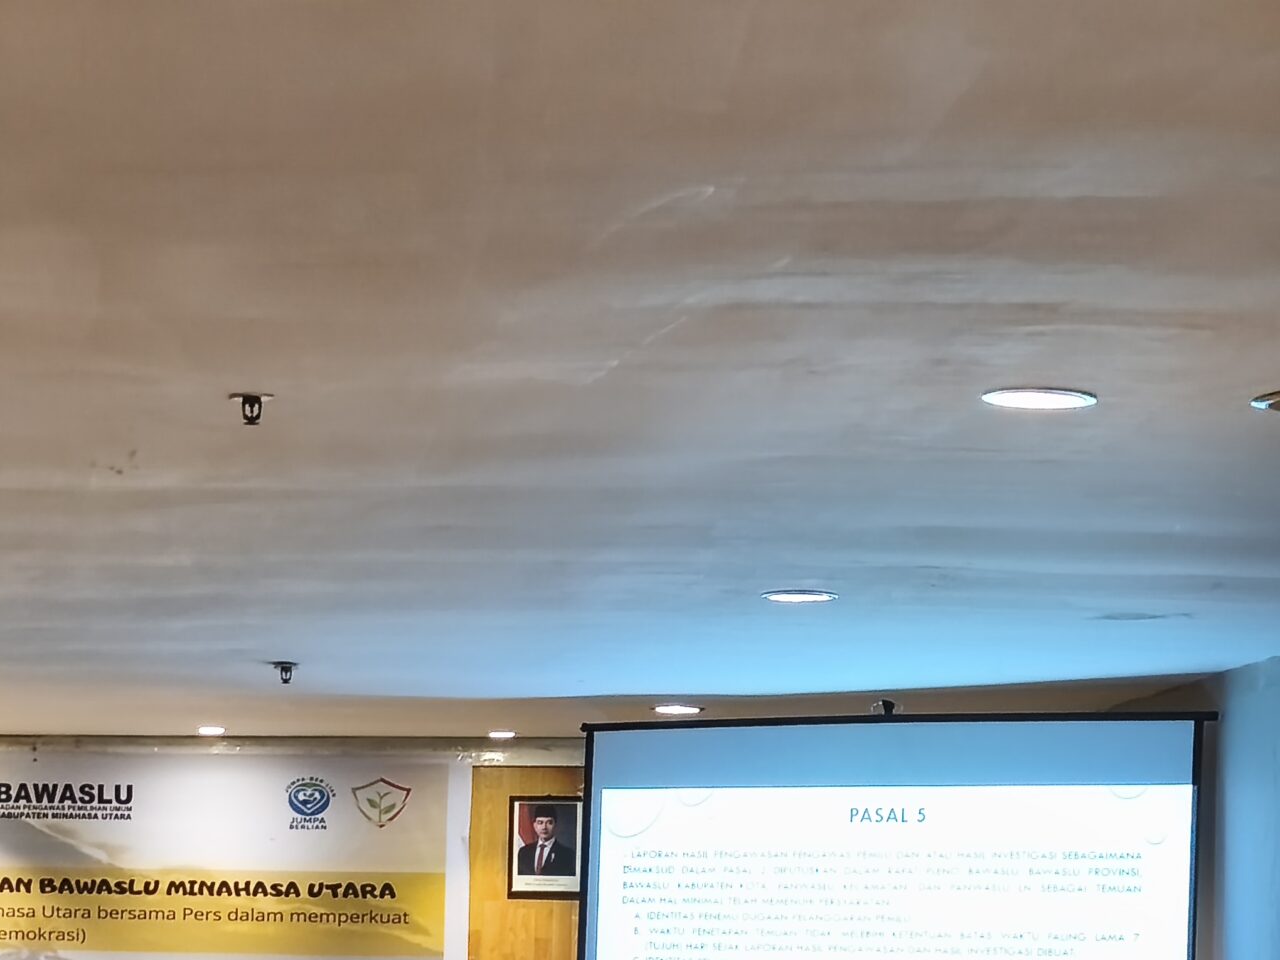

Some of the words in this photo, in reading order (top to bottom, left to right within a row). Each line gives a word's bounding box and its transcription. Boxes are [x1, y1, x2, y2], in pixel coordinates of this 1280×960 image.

[51, 813, 99, 821] MINAHASA
[101, 813, 132, 821] UTARA
[849, 807, 909, 823] PASAL
[917, 807, 927, 823] 5
[290, 817, 326, 825] JUMPA
[631, 850, 678, 859] LAPORAN
[683, 850, 708, 859] HASIL
[1062, 851, 1143, 860] SEBAGAIMANA
[681, 865, 716, 874] DALAM
[38, 877, 160, 897] BAWASLU
[165, 880, 301, 898] MINAHASA
[306, 882, 397, 899] UTARA
[622, 881, 670, 890] BAWASLU
[1096, 884, 1143, 893] TEMUAN
[622, 896, 657, 905] DALAM
[42, 905, 91, 920] Utara
[97, 905, 176, 922] bersama
[183, 906, 222, 922] Pers
[227, 907, 284, 924] dalam
[290, 909, 410, 926] memperkuat
[646, 912, 695, 921] IDENTITAS
[649, 927, 685, 936] WAKTU
[1047, 932, 1087, 941] PALING
[1095, 933, 1125, 942] LAMA
